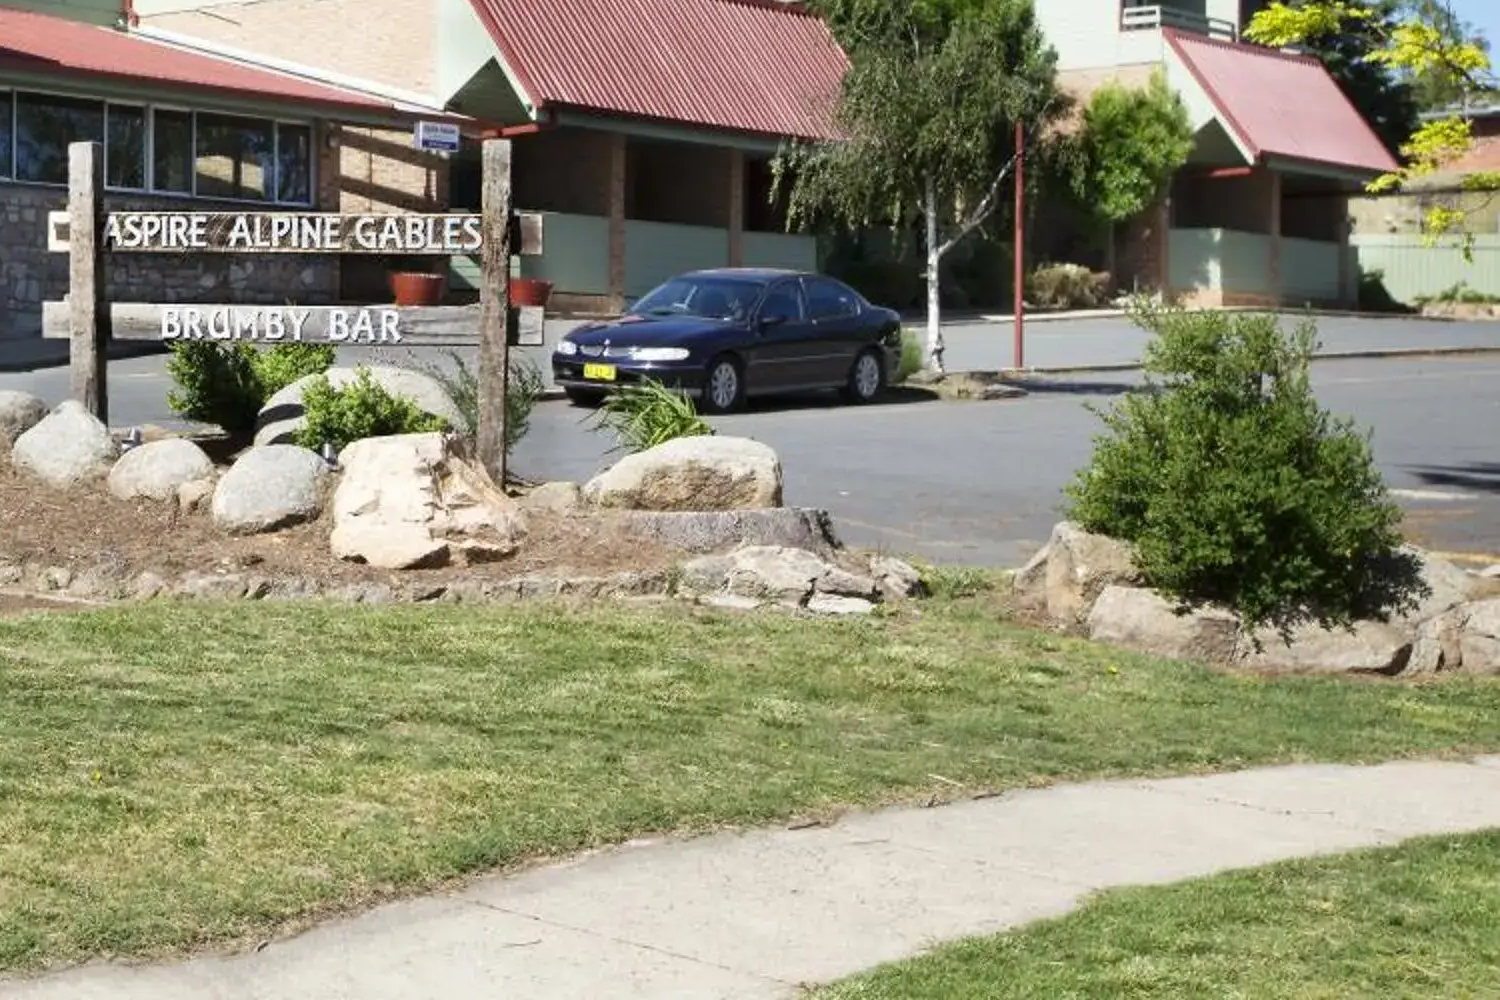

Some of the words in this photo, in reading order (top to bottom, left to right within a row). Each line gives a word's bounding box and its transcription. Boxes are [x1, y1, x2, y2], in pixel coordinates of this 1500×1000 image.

[103, 215, 208, 249] ASPIRE
[229, 215, 342, 250] ALPINE
[355, 216, 484, 250] GABLES
[160, 305, 312, 342] BRUMBY
[329, 307, 403, 343] BAR
